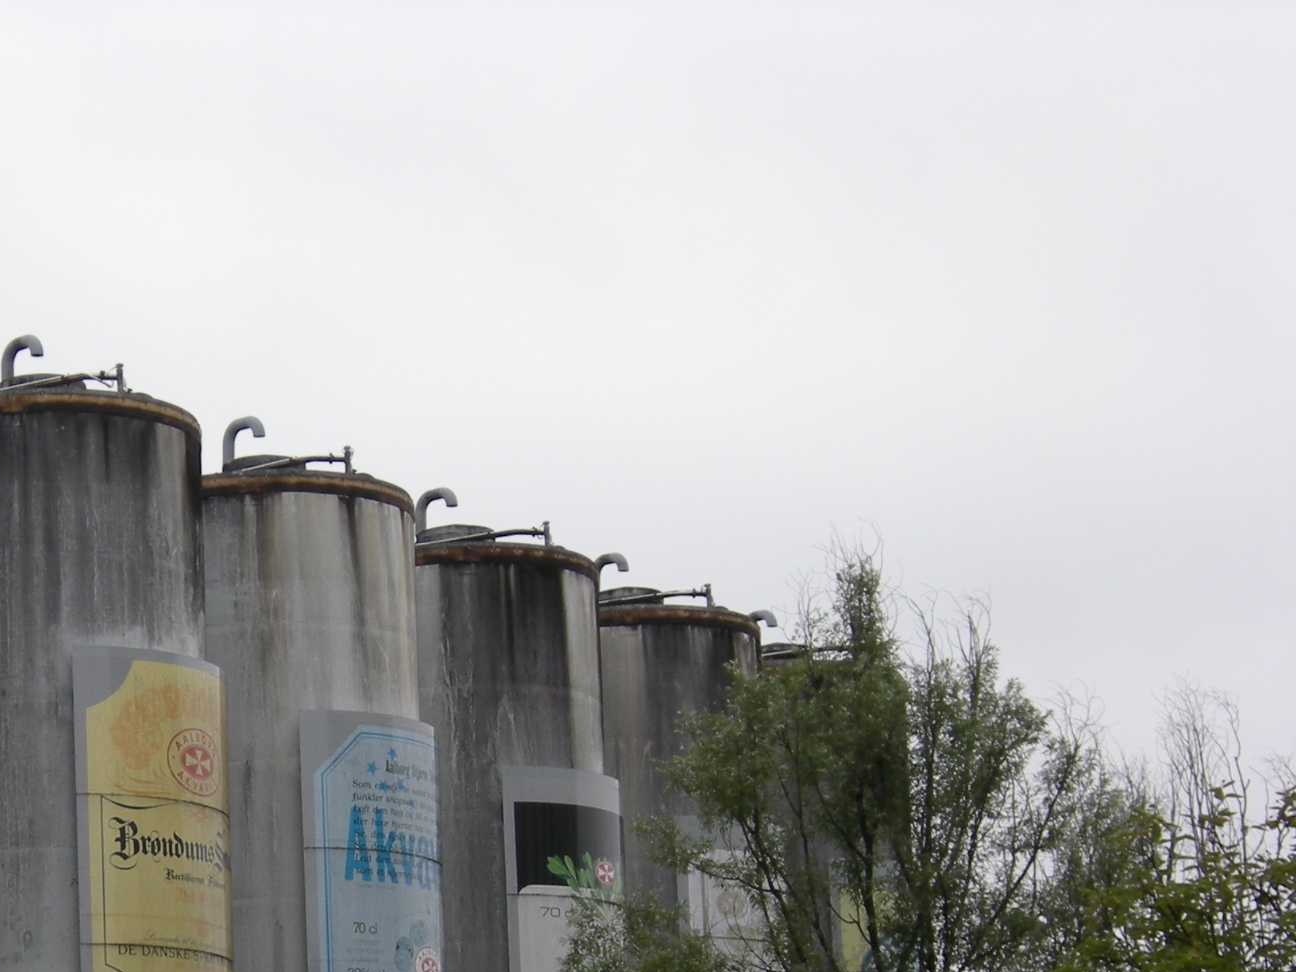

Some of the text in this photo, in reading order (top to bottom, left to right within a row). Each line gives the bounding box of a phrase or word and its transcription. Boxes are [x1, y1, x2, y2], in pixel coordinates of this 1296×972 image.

[175, 732, 216, 758] AALBORG
[540, 907, 561, 918] 70
[354, 921, 378, 935] 70 cl
[118, 944, 137, 956] DE
[142, 945, 190, 960] DANSKE
